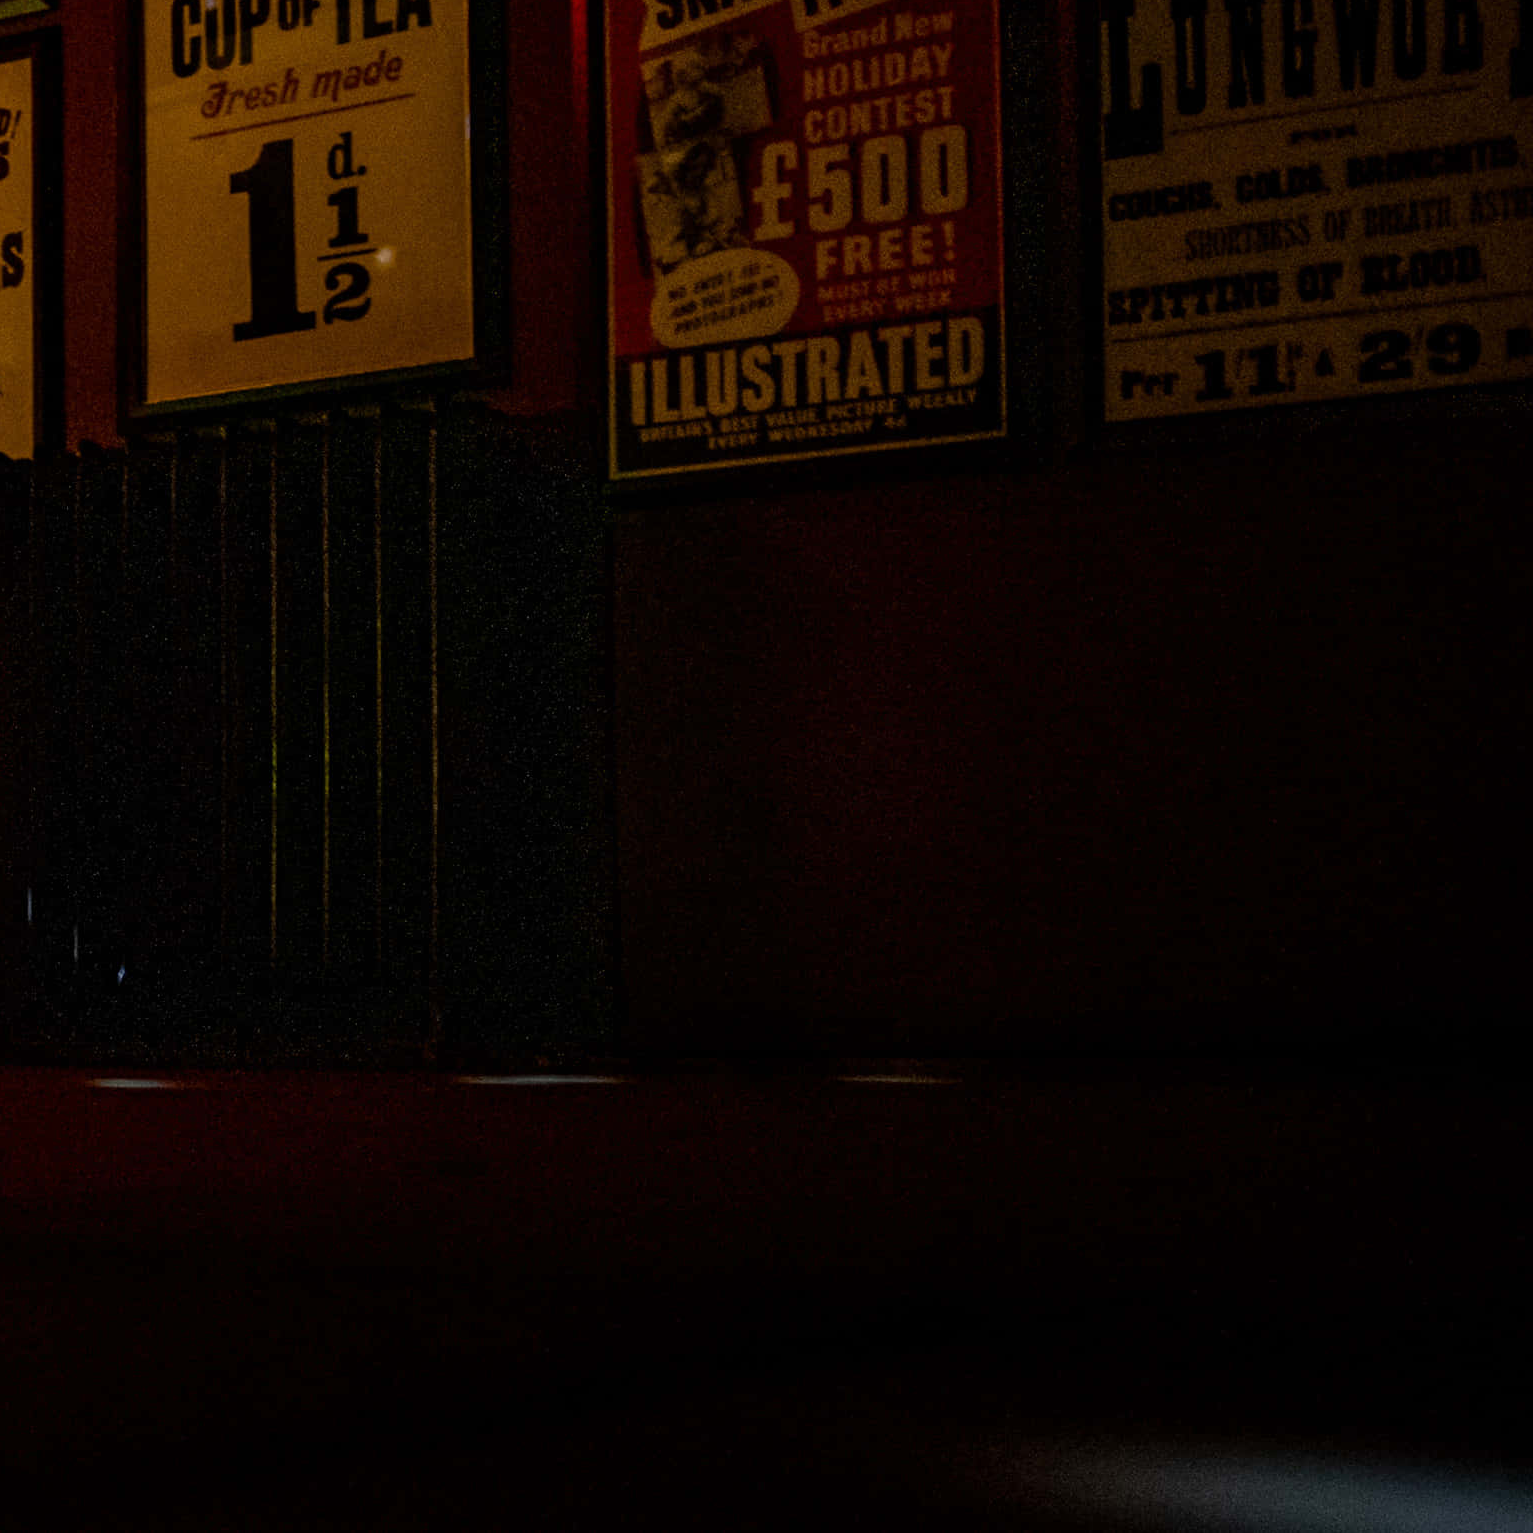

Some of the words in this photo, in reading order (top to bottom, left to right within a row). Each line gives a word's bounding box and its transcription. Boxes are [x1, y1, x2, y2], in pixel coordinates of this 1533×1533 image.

[803, 19, 888, 59] Brand
[894, 10, 954, 42] New
[200, 68, 299, 120] Fresh
[310, 50, 402, 102] made
[803, 43, 953, 104] HOLIDAY
[805, 85, 956, 144] CONTEST
[752, 124, 968, 242] £500
[815, 220, 956, 281] FREE!
[1185, 214, 1310, 262] SHORTNESS
[1324, 209, 1350, 242] OF
[817, 280, 870, 302] MUST
[876, 276, 900, 295] BE
[909, 268, 956, 289] WON
[823, 298, 886, 322] EVERY
[895, 290, 951, 312] WEEK
[1109, 271, 1279, 326] SPITTING
[1298, 262, 1342, 302] OF
[630, 316, 986, 426] ILLUSTRATED
[1121, 370, 1180, 400] Per
[707, 432, 759, 450] EVERY
[768, 420, 873, 442] WEDNESDAY
[721, 417, 759, 433] BEST
[766, 409, 818, 427] VALUE
[827, 398, 898, 419] PICTURE
[906, 389, 978, 411] WEEKLY
